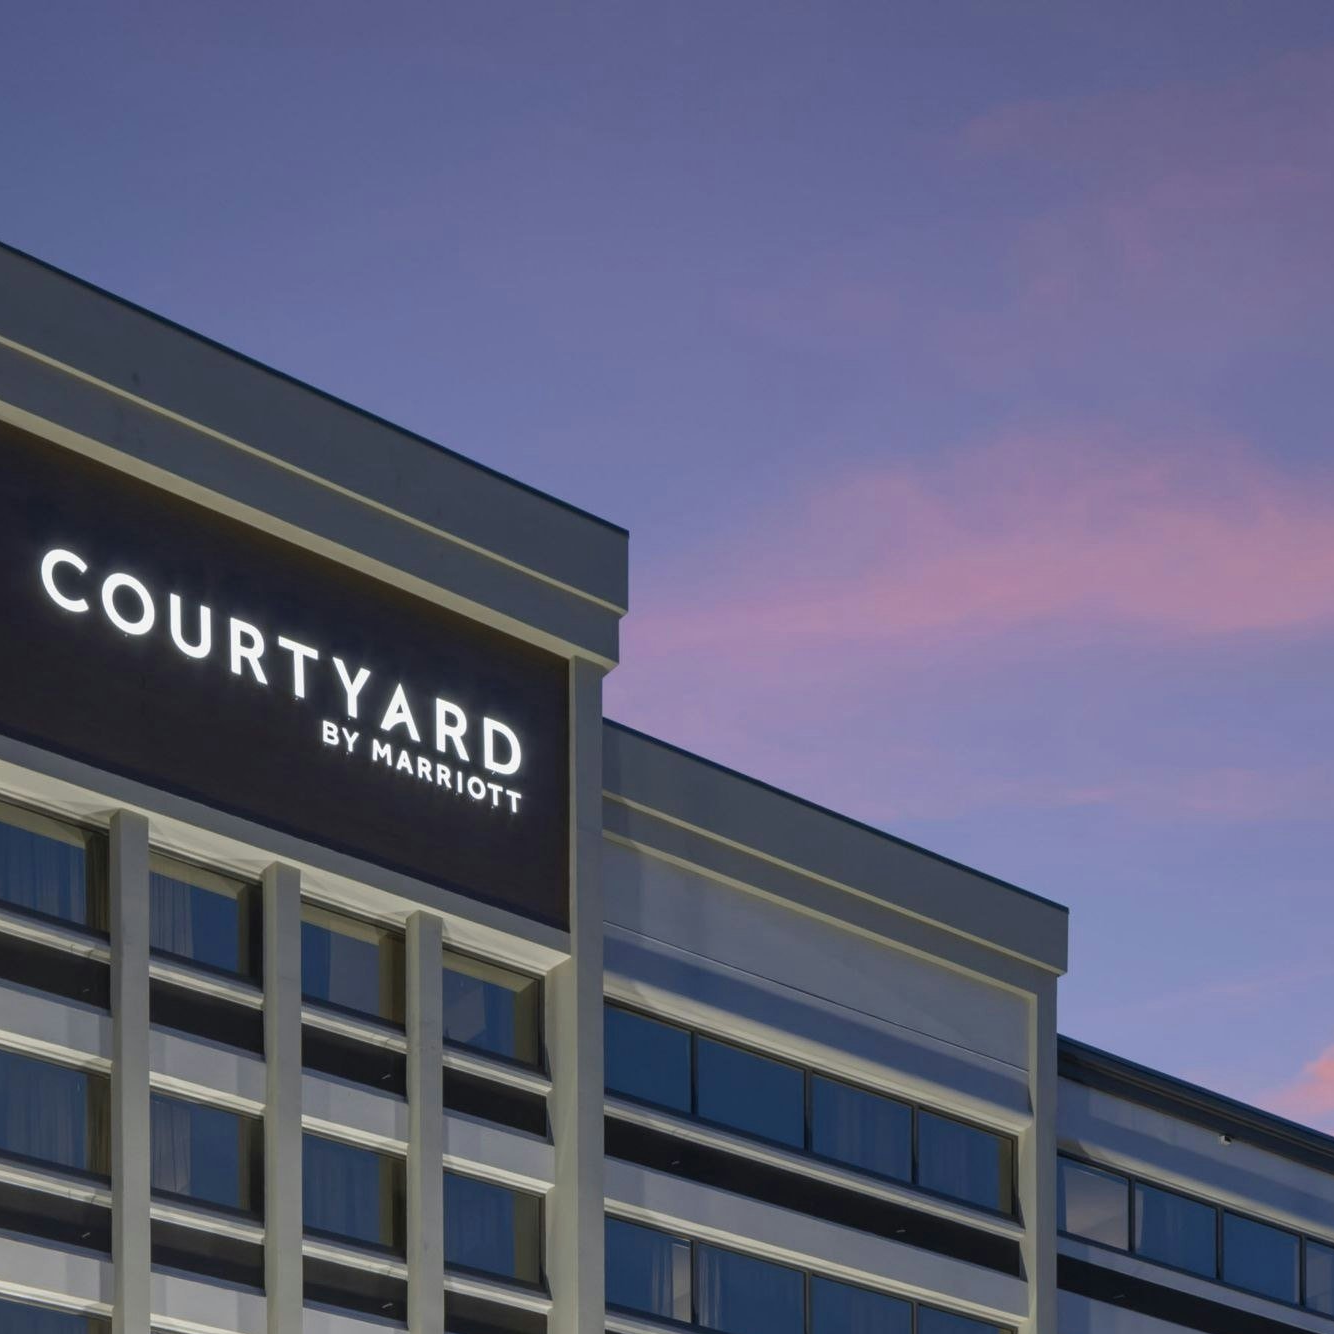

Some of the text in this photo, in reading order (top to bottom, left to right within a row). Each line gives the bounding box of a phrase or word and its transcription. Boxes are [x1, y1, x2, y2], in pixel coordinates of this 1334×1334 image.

[40, 548, 522, 775] COURTYARD
[322, 719, 522, 813] BY MARRIOTT
